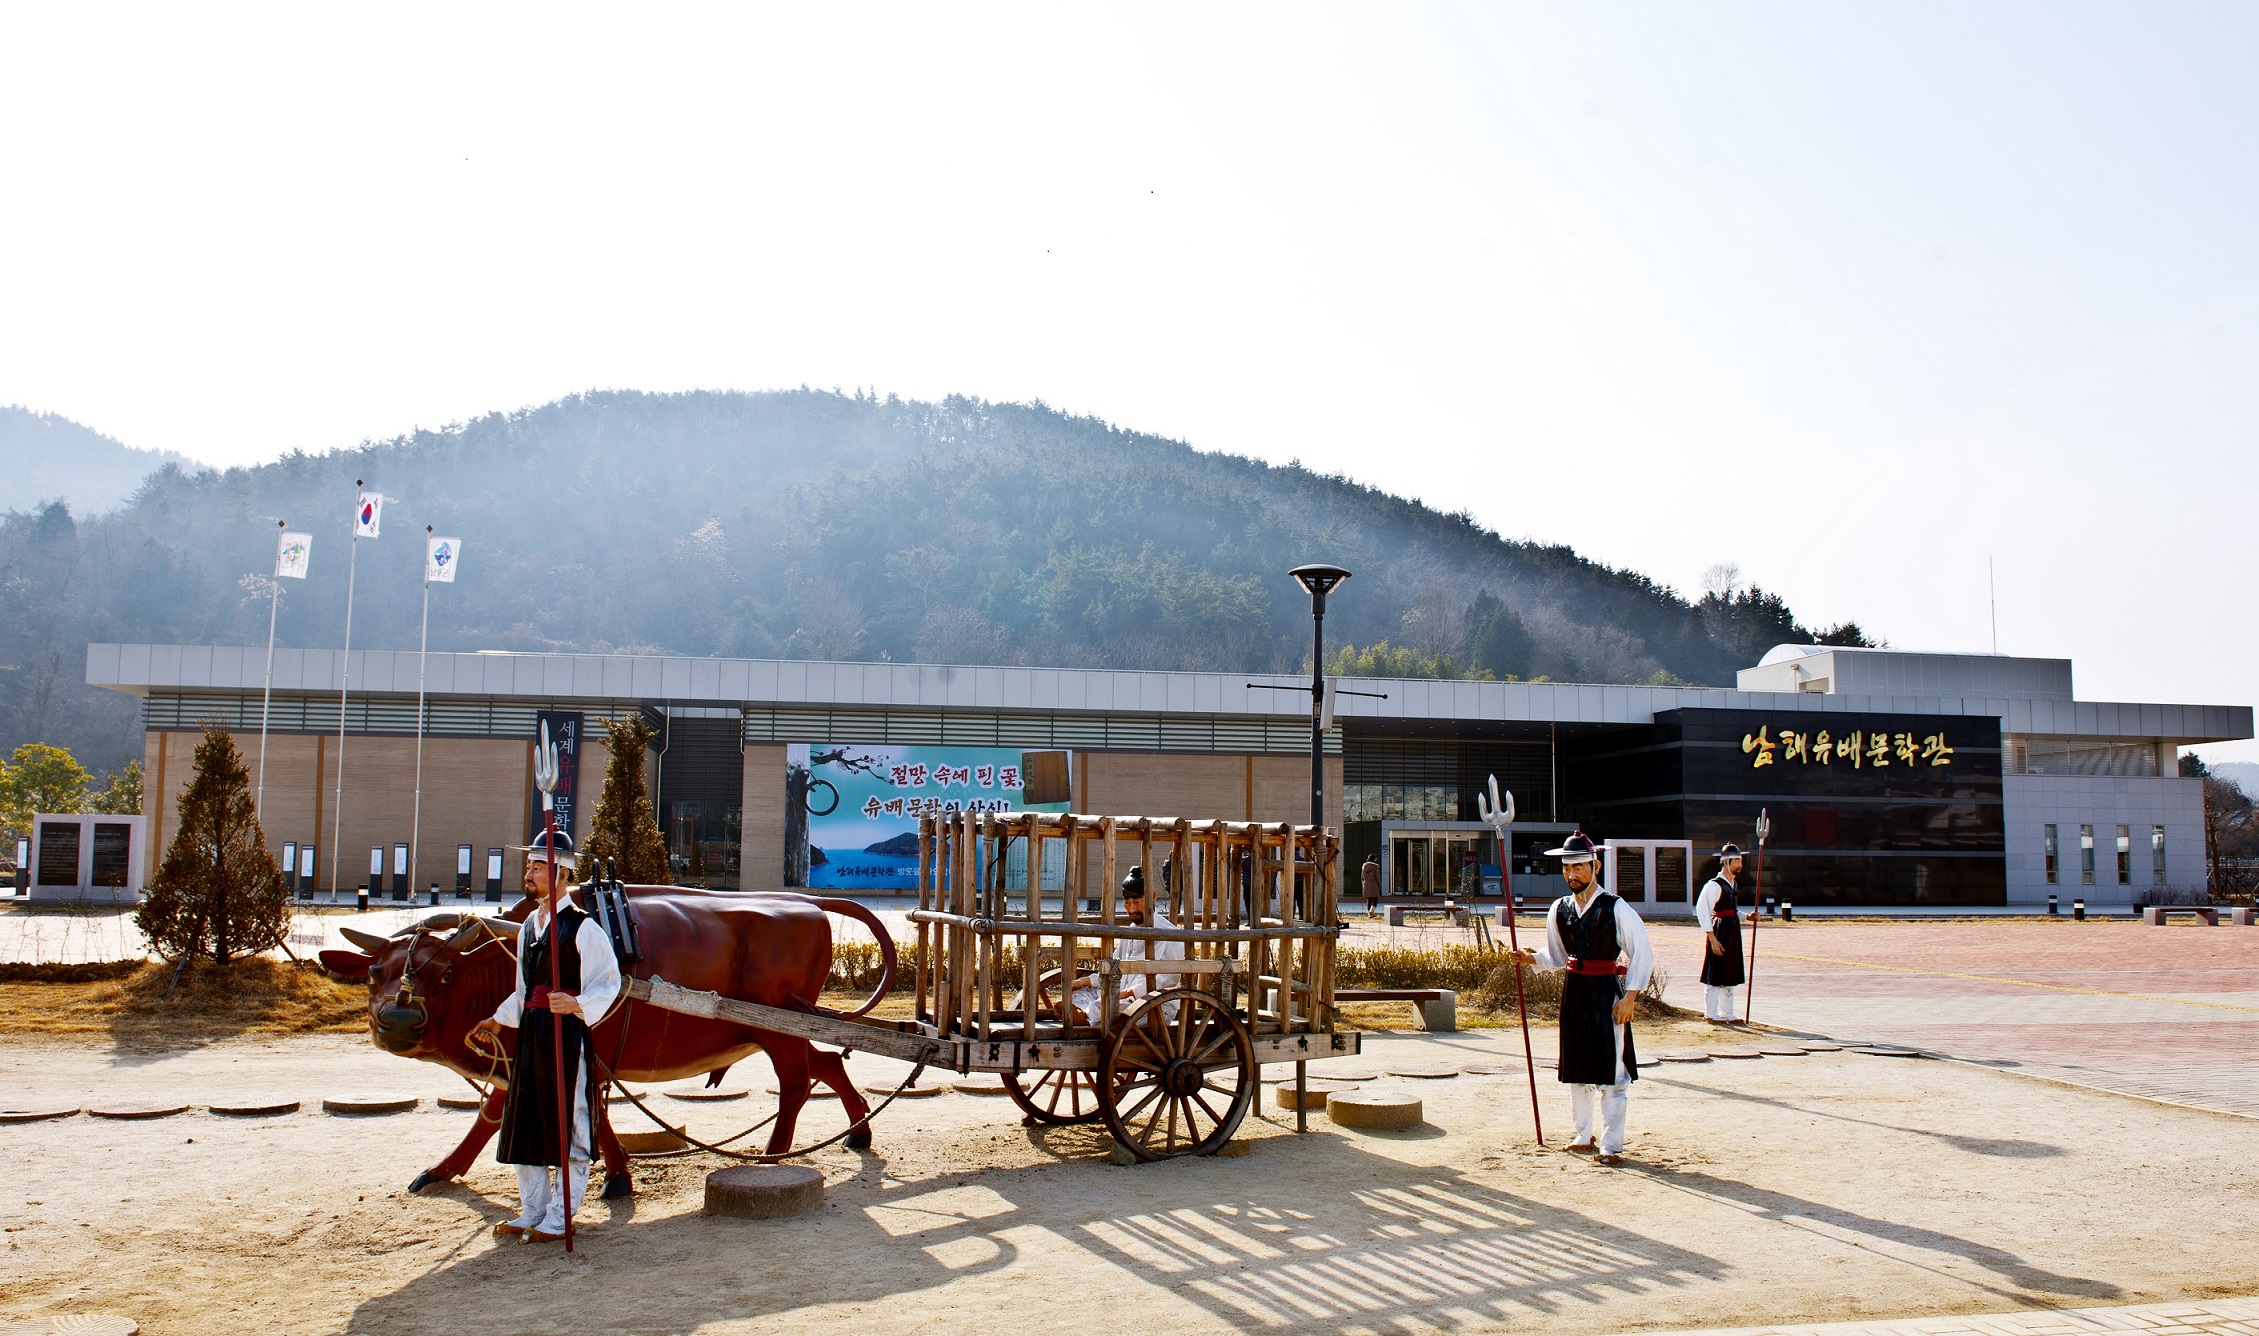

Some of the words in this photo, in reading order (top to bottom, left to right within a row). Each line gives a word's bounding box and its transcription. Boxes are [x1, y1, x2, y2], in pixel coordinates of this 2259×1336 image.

[1742, 725, 1954, 769] 남해유배문학관
[891, 765, 927, 785] 절망
[934, 766, 968, 785] 속에
[977, 767, 992, 785] 핀
[1000, 768, 1022, 787] 꽃,
[863, 797, 959, 818] 유배문학의
